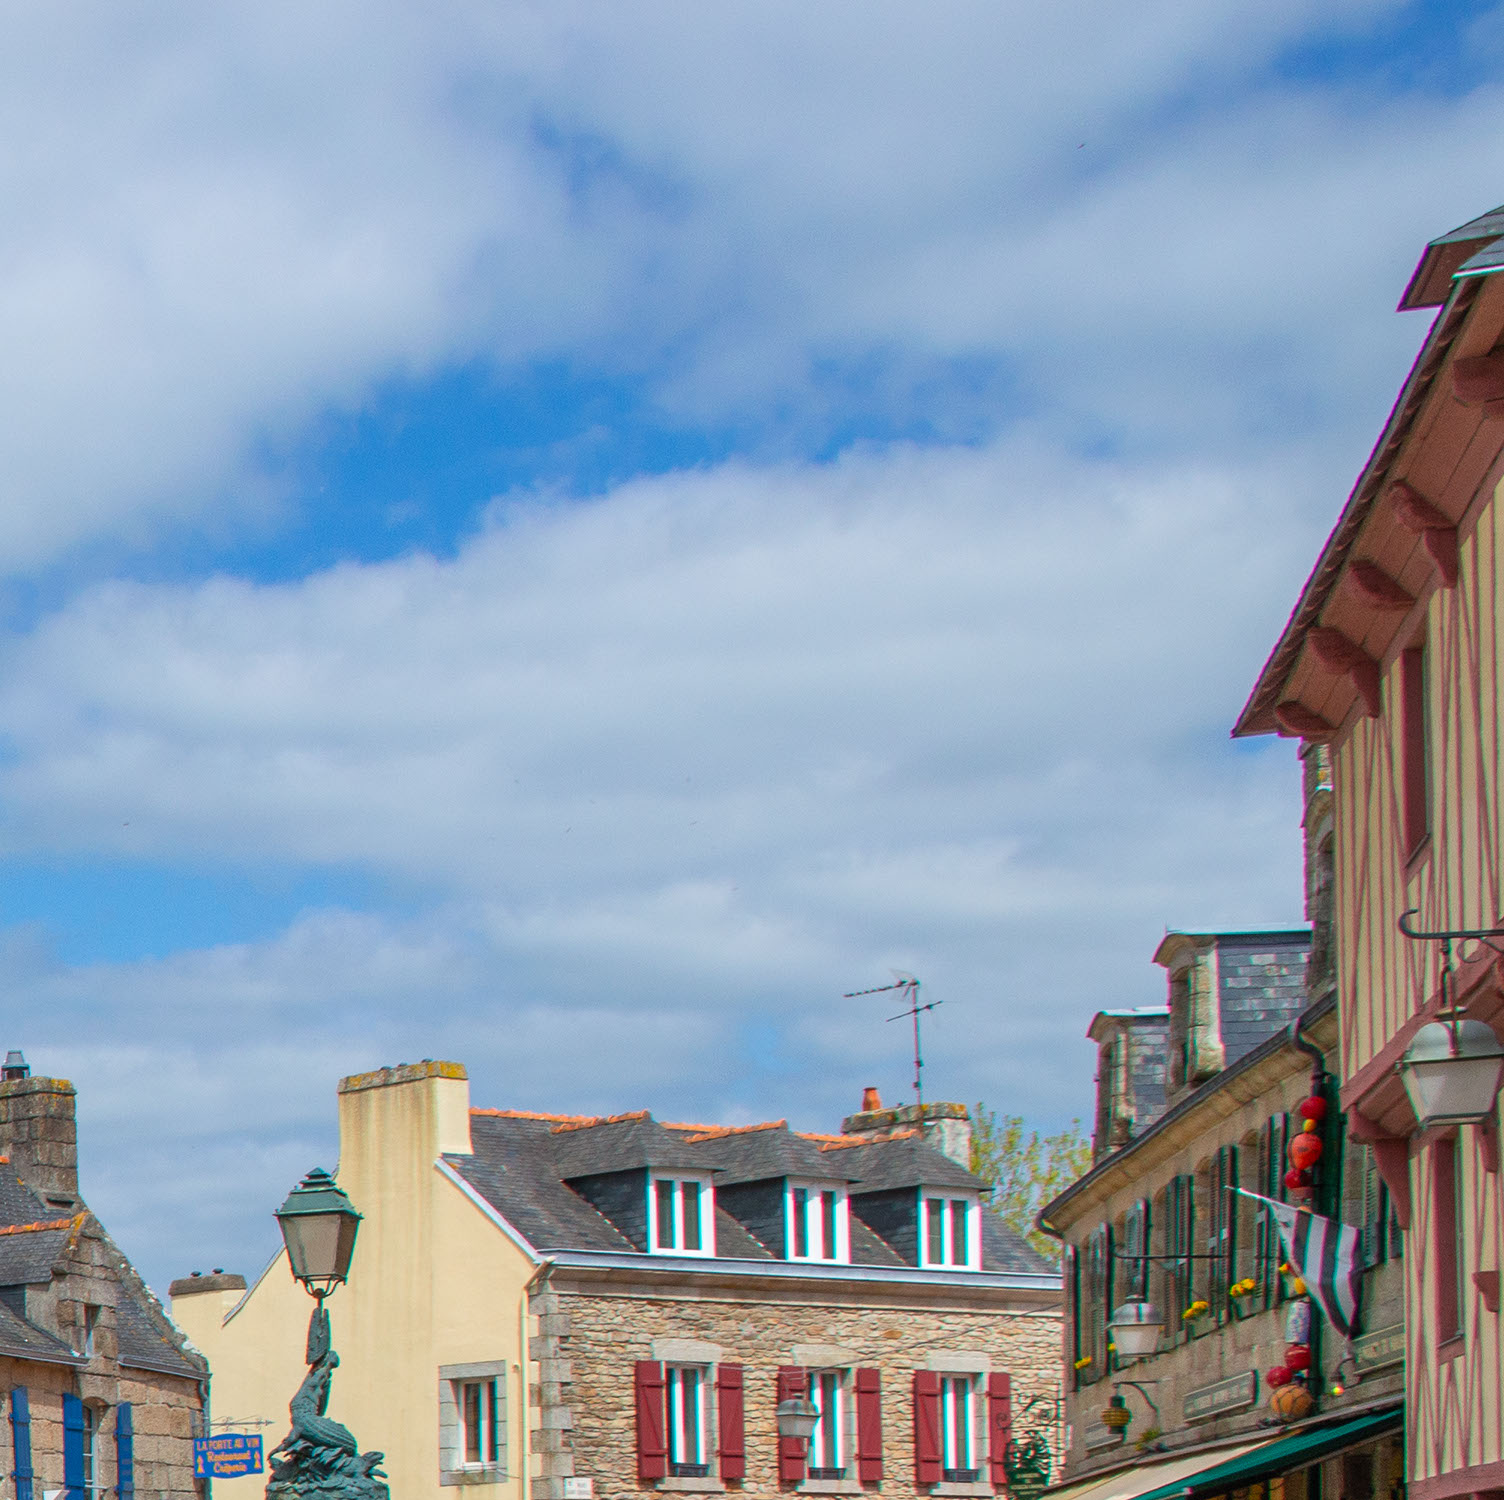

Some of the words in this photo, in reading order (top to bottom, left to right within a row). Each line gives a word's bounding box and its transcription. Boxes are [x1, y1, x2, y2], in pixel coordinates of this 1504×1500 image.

[196, 1441, 208, 1451] LA
[209, 1439, 232, 1450] PORTE
[234, 1438, 244, 1448] AU
[246, 1437, 260, 1448] VIN
